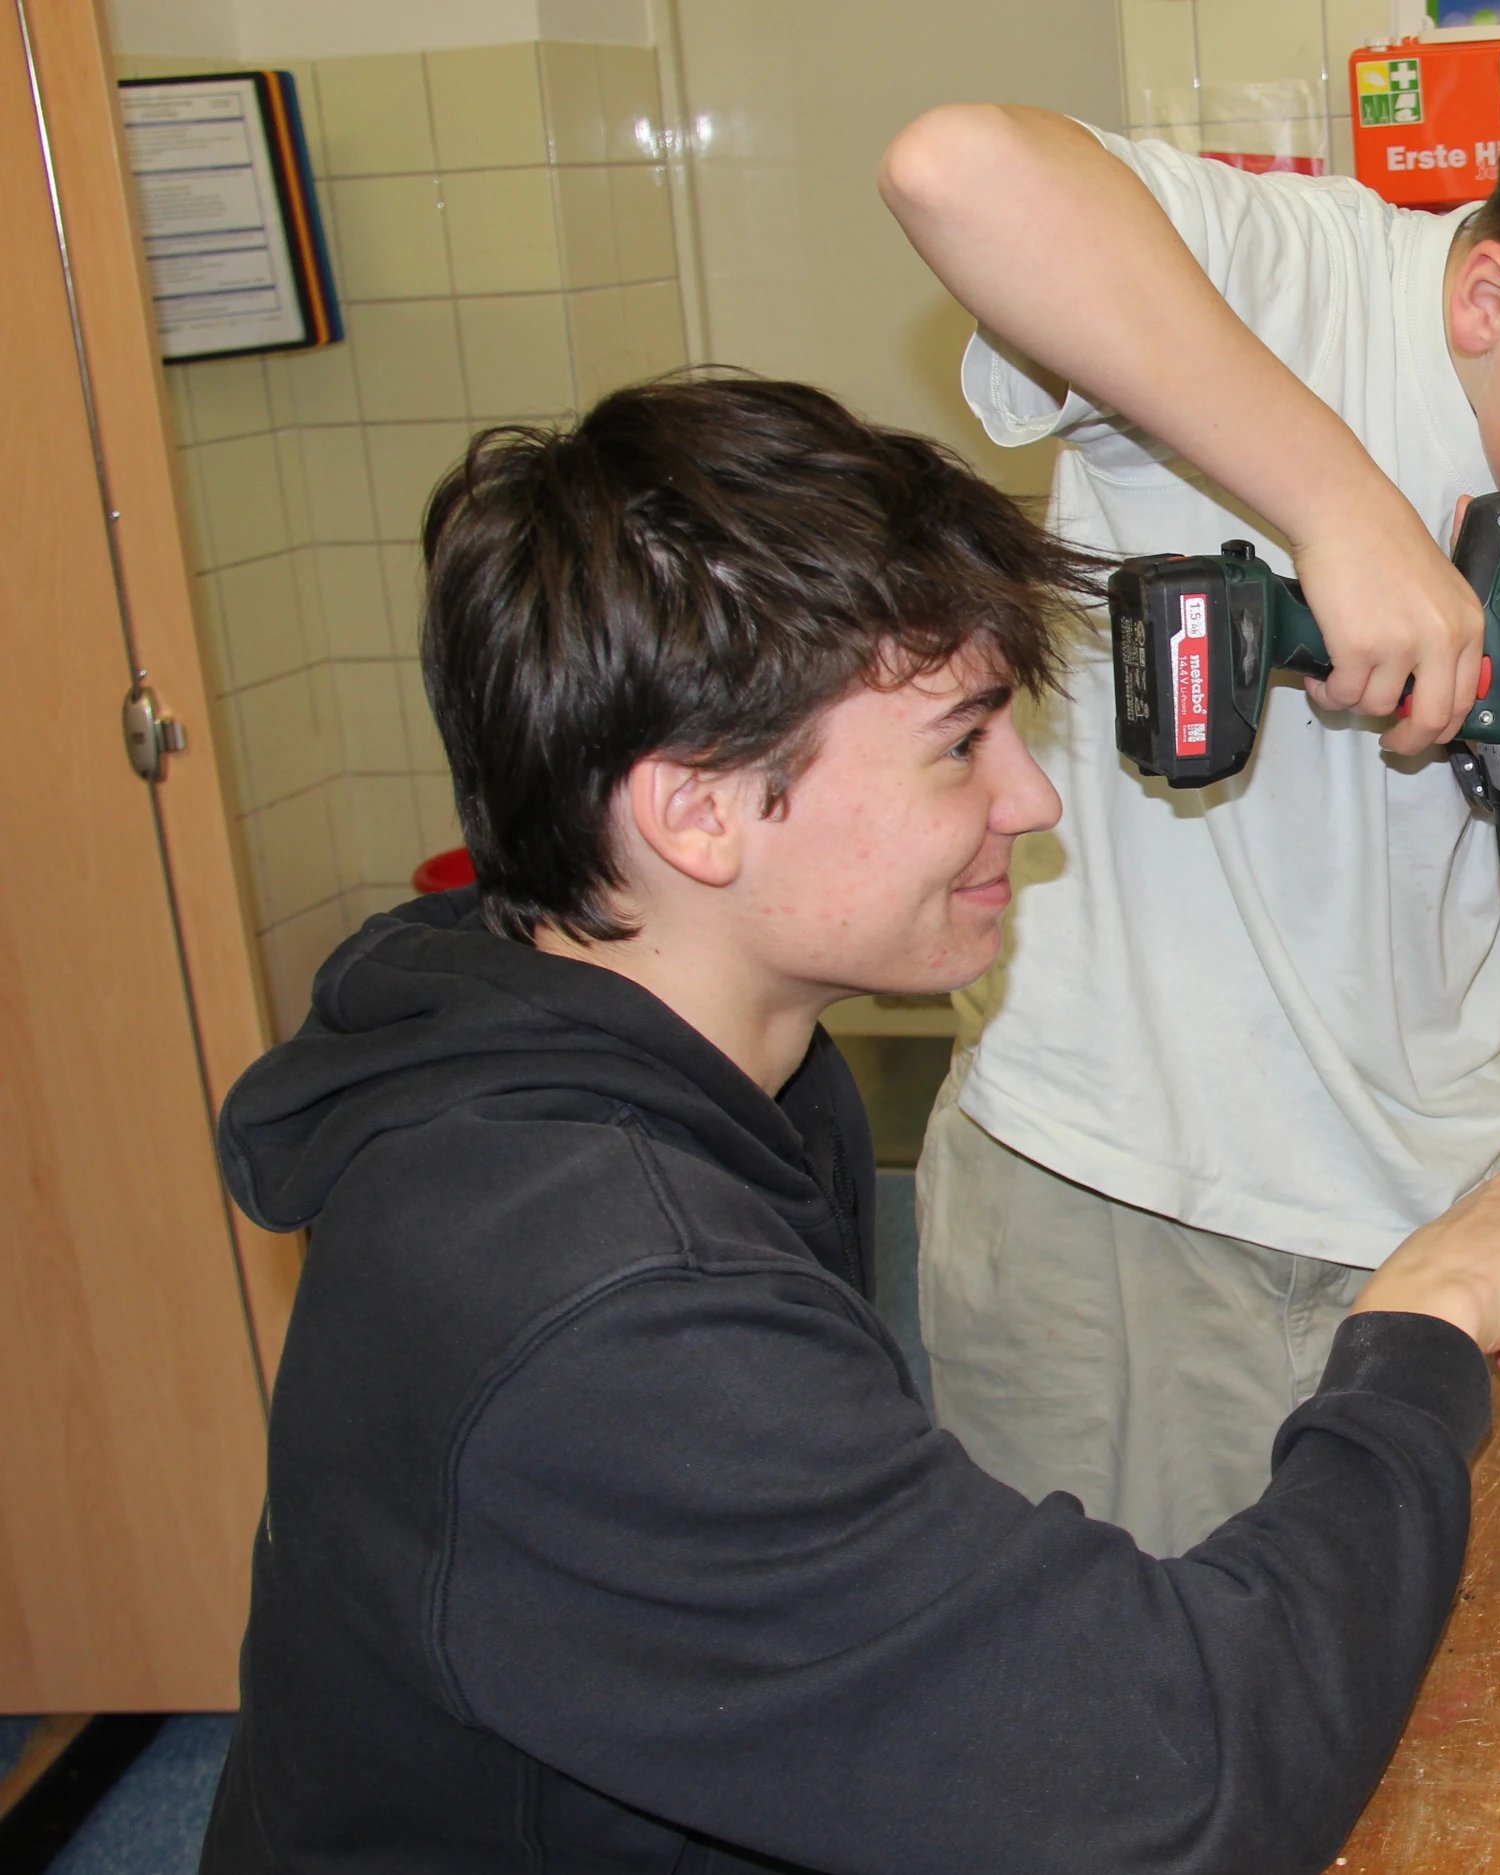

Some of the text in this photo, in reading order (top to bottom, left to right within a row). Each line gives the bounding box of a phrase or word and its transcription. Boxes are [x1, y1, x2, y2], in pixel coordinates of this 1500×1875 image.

[1386, 144, 1467, 171] Erste
[1190, 603, 1201, 634] 1.5 Ah
[1179, 656, 1188, 675] 14.4
[1190, 655, 1205, 714] metabo
